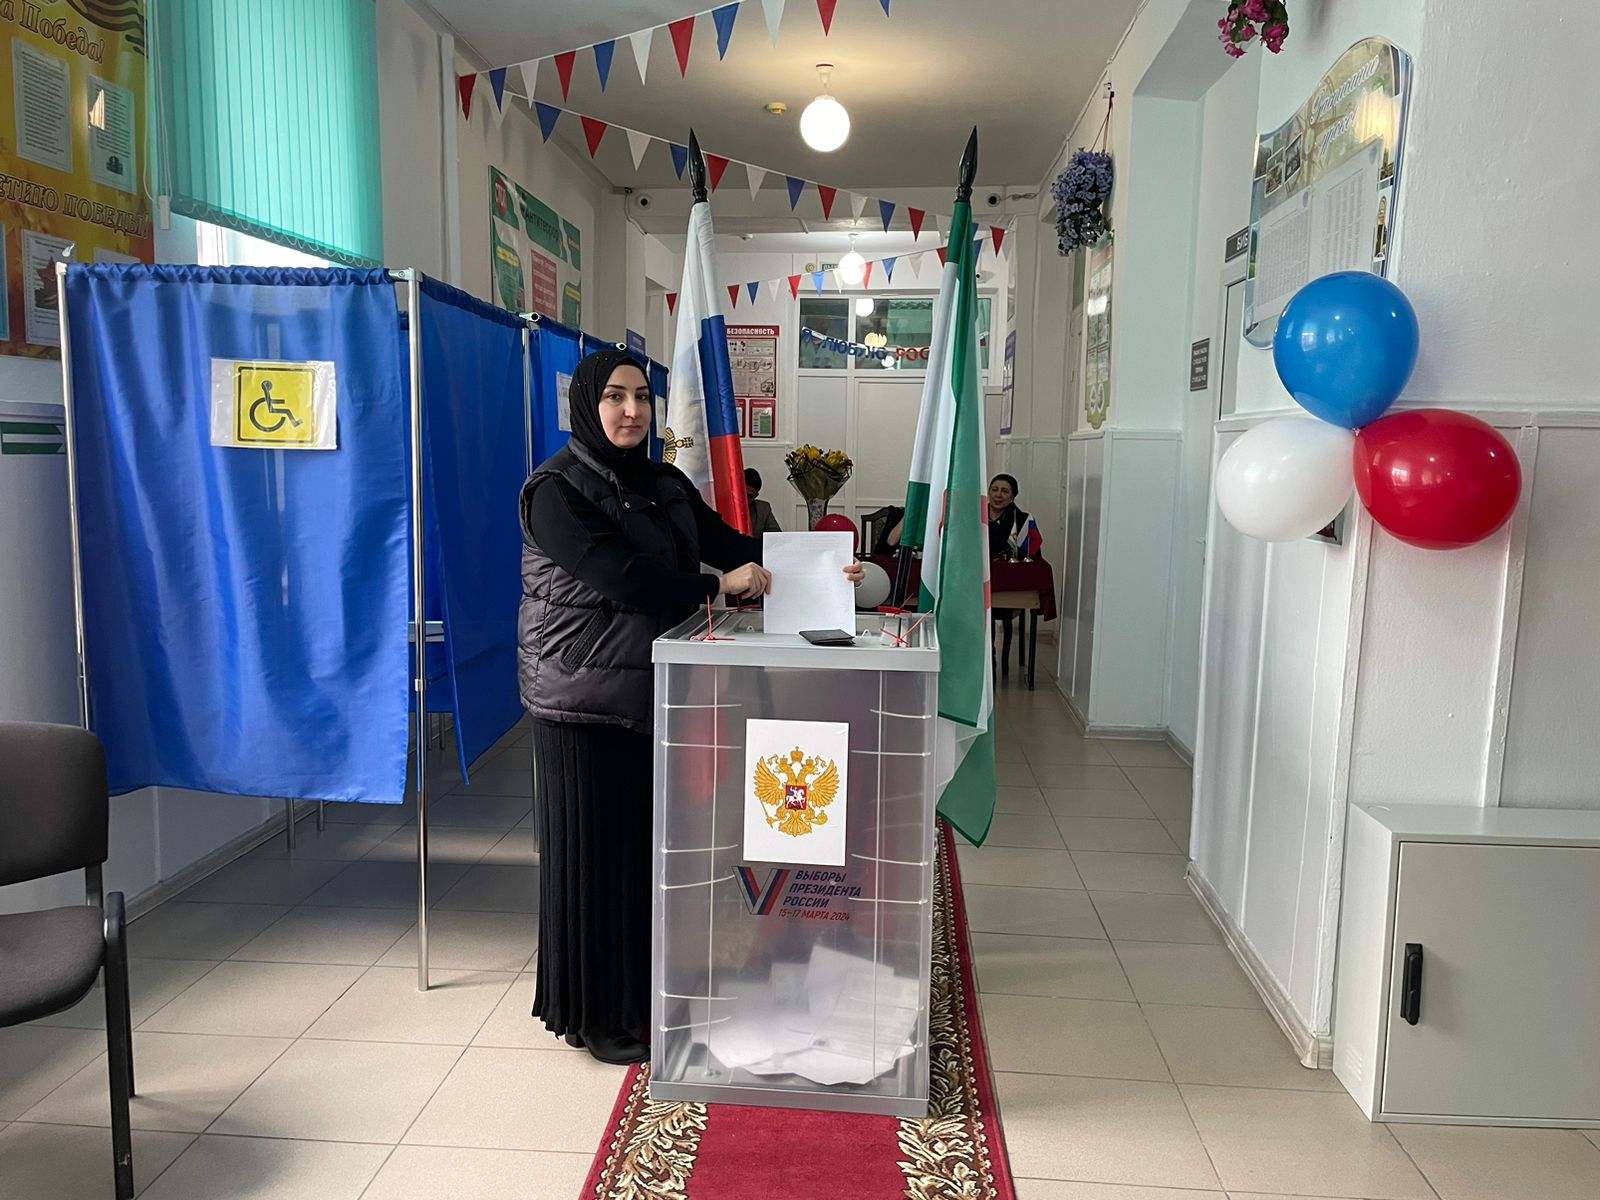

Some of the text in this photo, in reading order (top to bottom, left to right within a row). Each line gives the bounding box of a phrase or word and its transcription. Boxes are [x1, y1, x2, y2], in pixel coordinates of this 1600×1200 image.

[20, 1, 105, 64] Победа!
[62, 193, 149, 237] ПОБЕДЫ!
[726, 327, 776, 336] БЕЗОПАСНОСТЬ
[795, 870, 847, 883] ВЫБОРЫ
[789, 883, 862, 897] ПРЕЗИДЕНТА
[783, 896, 830, 909] РОССИИ
[801, 909, 828, 920] МАРТА
[830, 911, 850, 921] 2024
